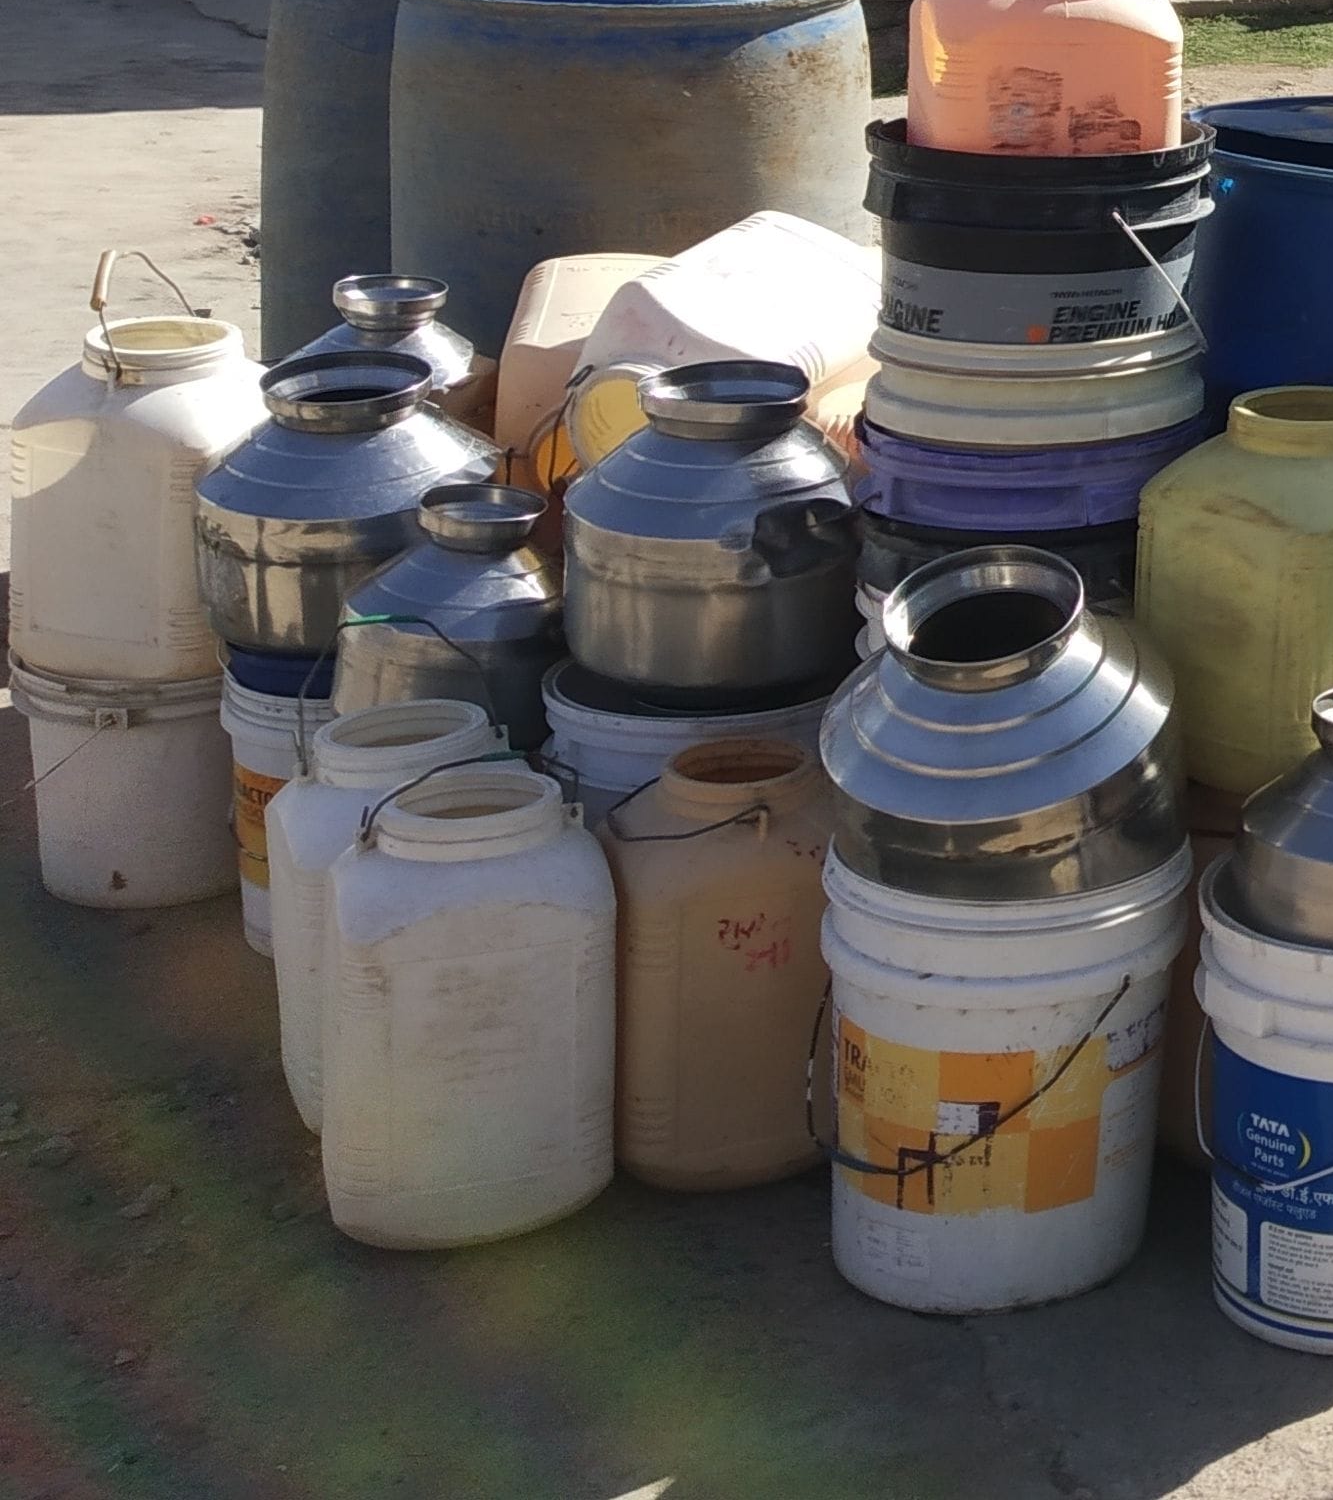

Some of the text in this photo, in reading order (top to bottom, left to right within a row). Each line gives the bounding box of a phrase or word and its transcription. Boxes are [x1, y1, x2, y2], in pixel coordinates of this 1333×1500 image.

[1053, 300, 1141, 323] ENGINE
[1048, 316, 1152, 343] PREMIUM
[1250, 1112, 1290, 1138] TATA
[1245, 1127, 1297, 1155] Genuine
[1254, 1146, 1285, 1168] Parts
